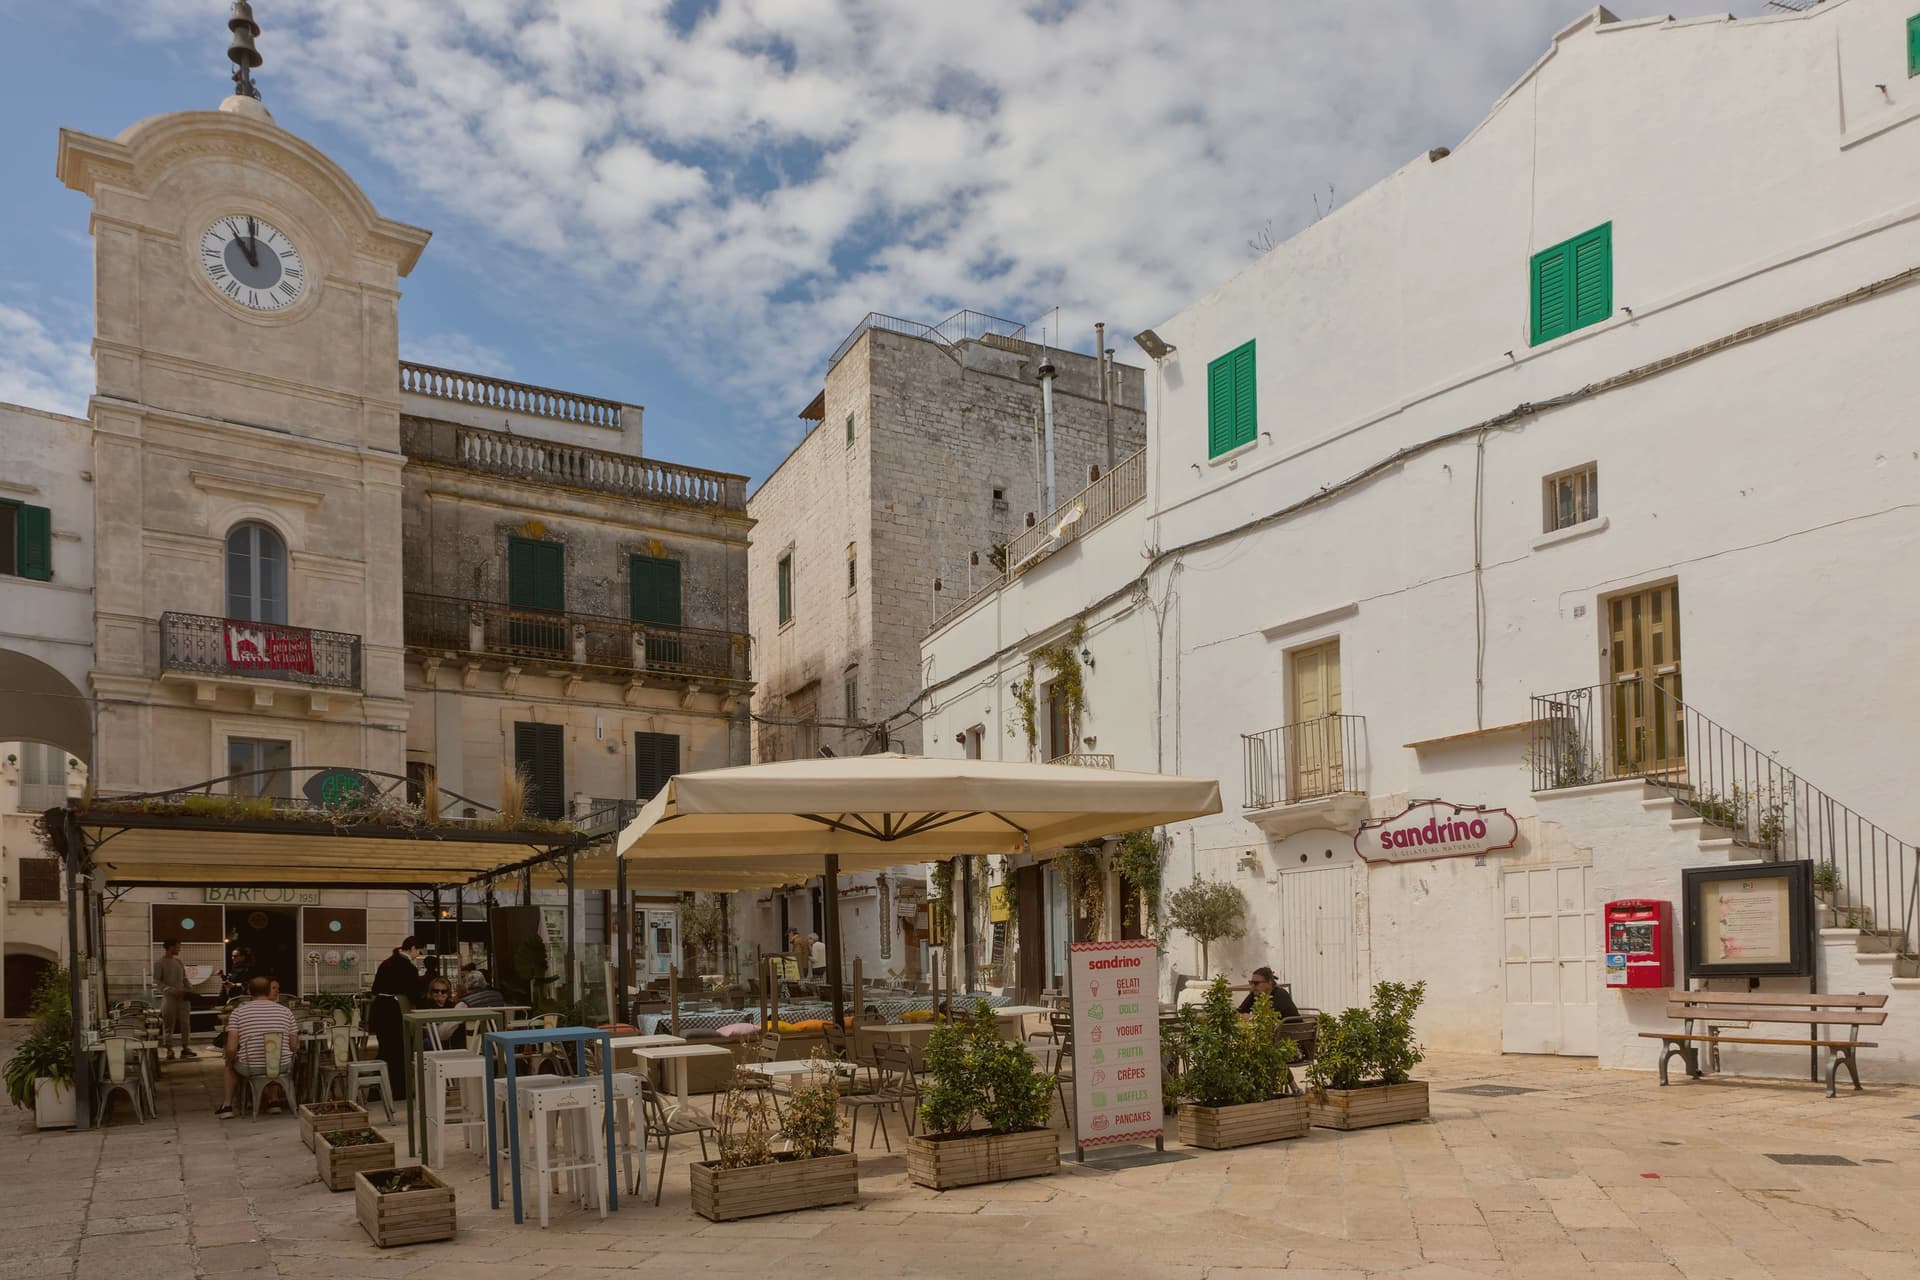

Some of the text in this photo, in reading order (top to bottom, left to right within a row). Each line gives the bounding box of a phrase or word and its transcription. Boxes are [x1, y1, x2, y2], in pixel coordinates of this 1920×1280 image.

[1379, 817, 1488, 850] sandrino
[298, 894, 317, 903] 1951
[1088, 955, 1142, 970] sandrino
[1116, 977, 1140, 989] GELATI
[1119, 1003, 1139, 1015] DOLCI
[1116, 1024, 1143, 1037] YOGURT
[1117, 1045, 1144, 1058] FRUTTA
[1117, 1067, 1146, 1081] CRÊPES
[1116, 1089, 1148, 1104] WAFFLES
[1115, 1111, 1152, 1126] PANCAKES
